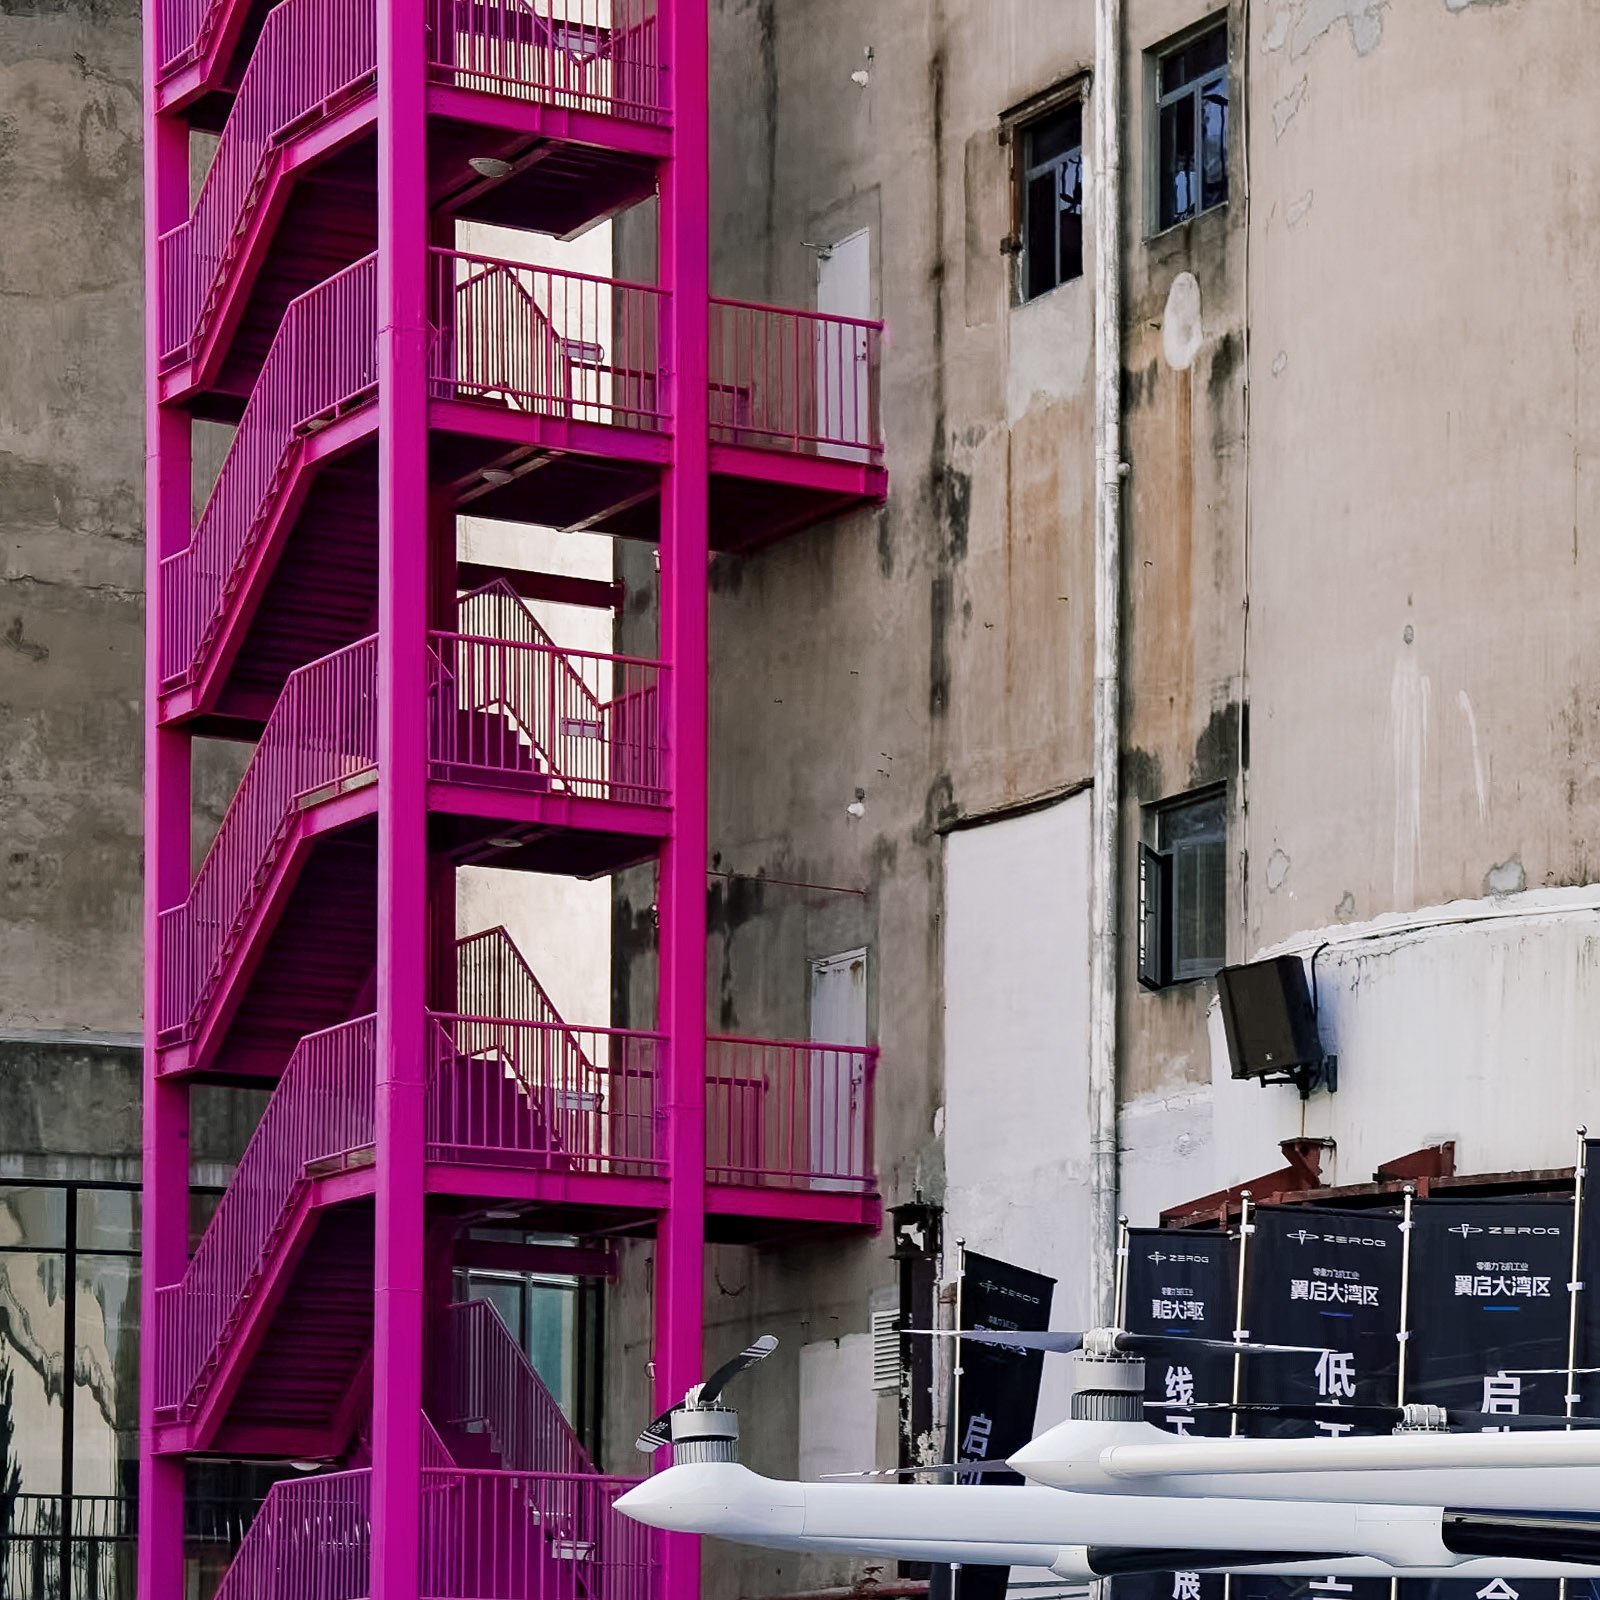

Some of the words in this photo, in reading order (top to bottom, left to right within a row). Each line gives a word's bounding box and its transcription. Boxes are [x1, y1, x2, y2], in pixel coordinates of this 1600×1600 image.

[1488, 1226, 1560, 1236] ZEROG
[1323, 1234, 1386, 1247] ZEROG
[1169, 1254, 1210, 1263] ZEROG
[1454, 1274, 1551, 1297] 翼启大湾区
[1290, 1279, 1380, 1306] 翼启大湾区
